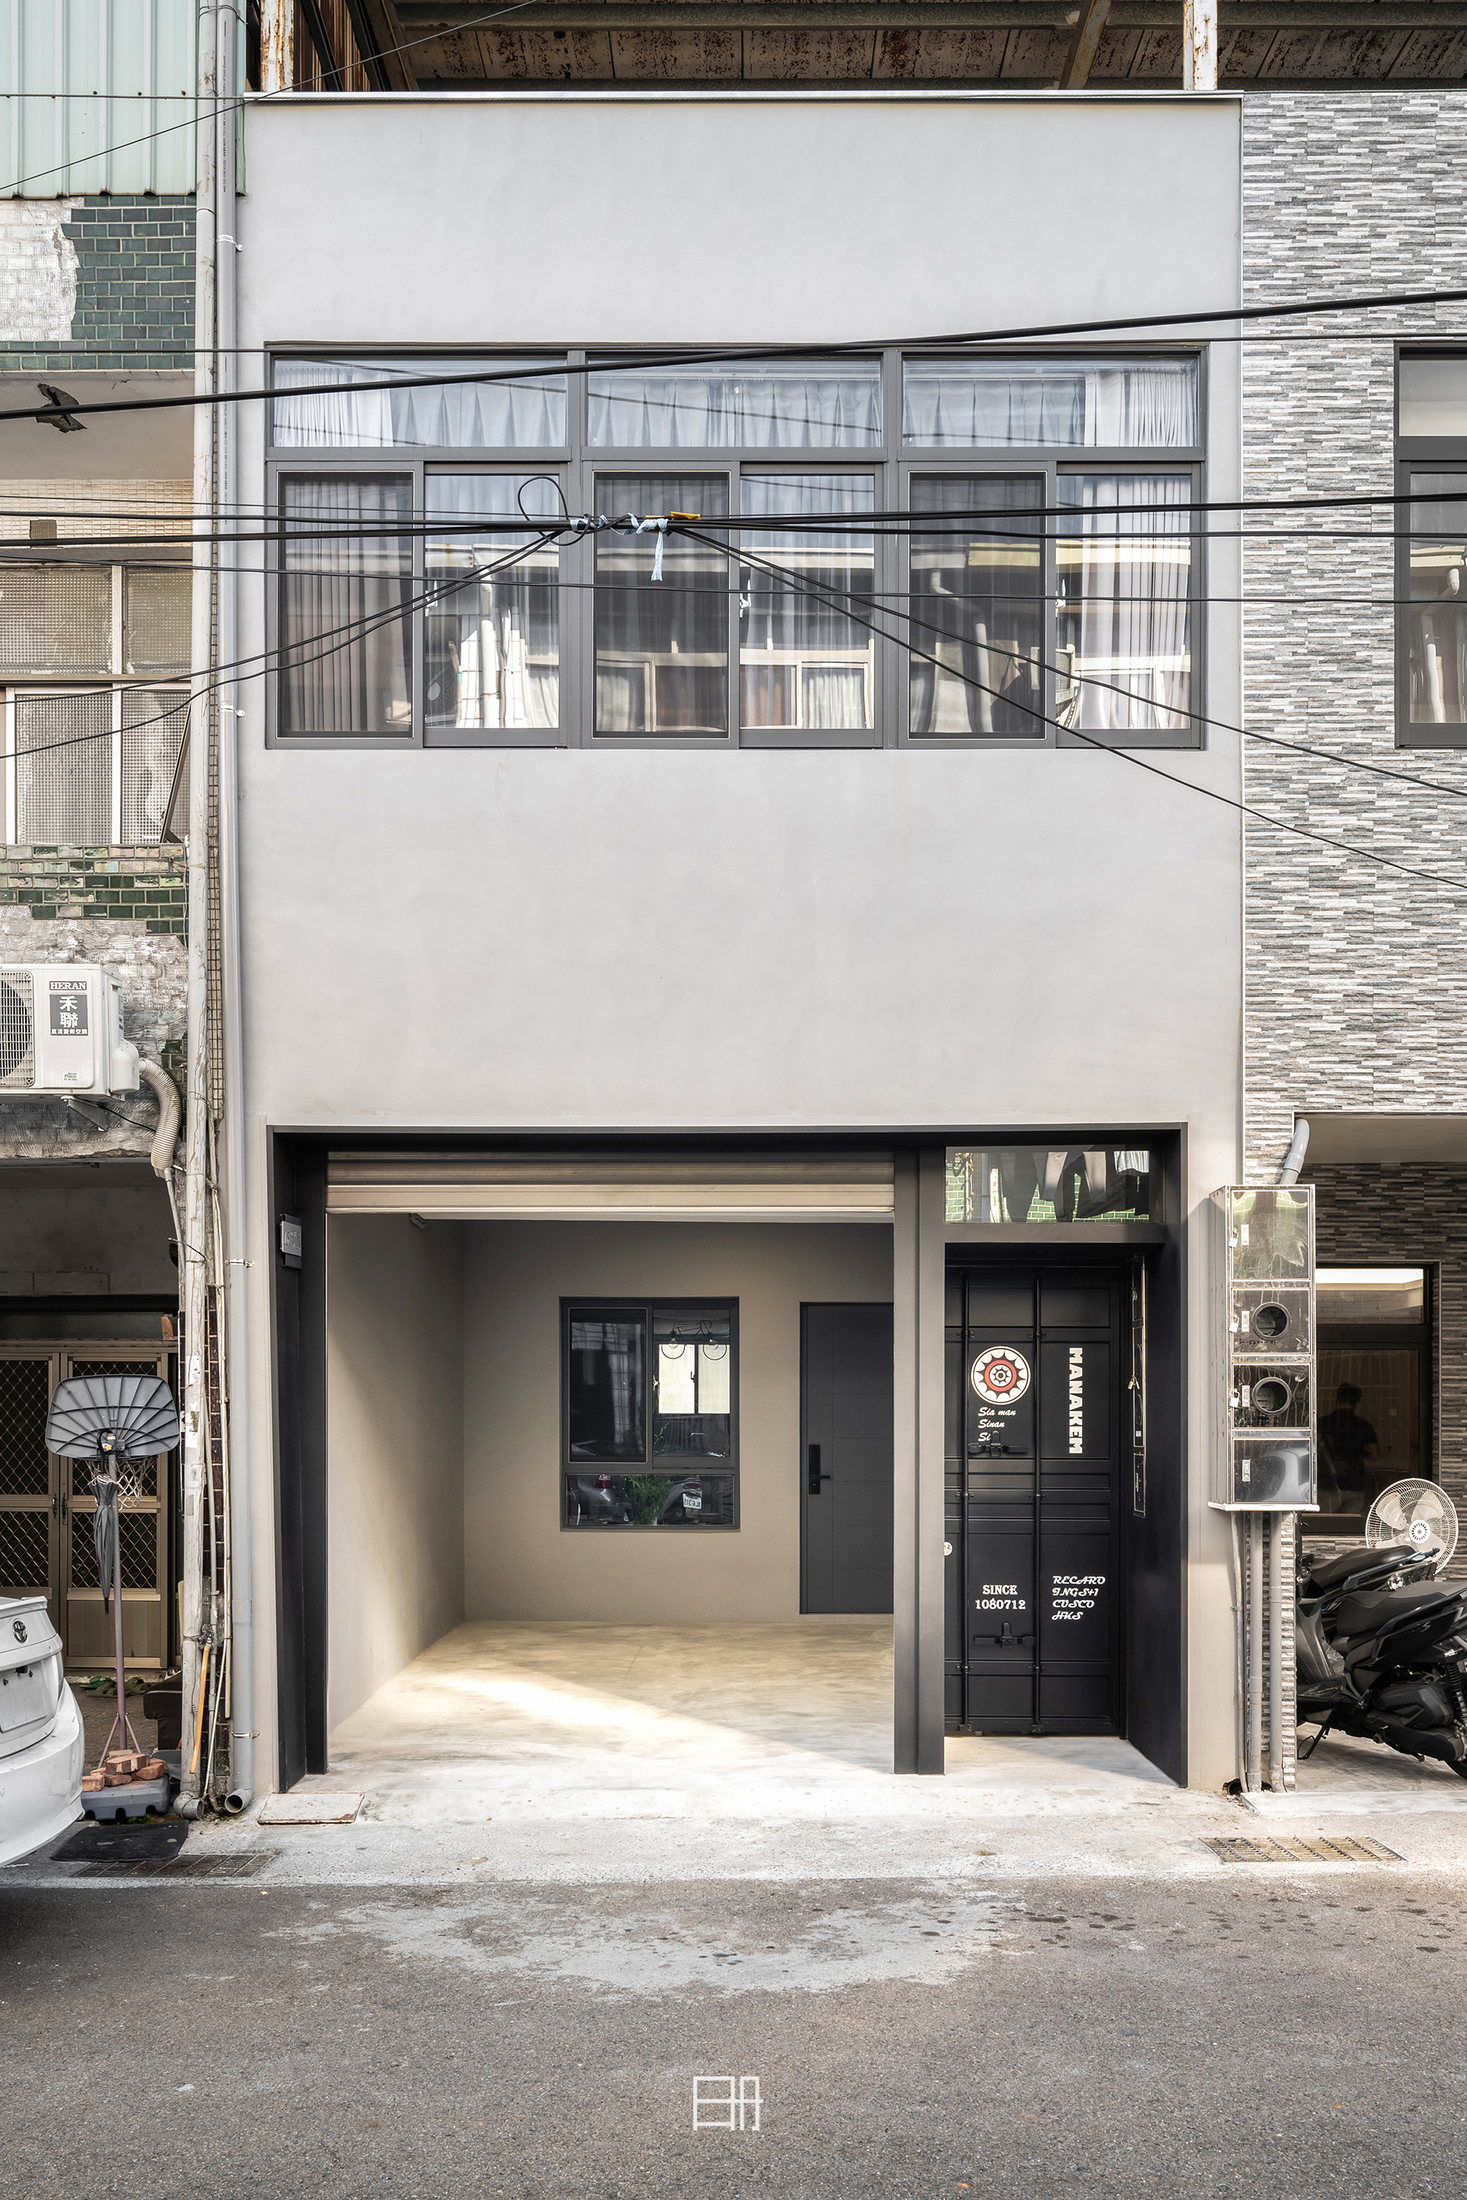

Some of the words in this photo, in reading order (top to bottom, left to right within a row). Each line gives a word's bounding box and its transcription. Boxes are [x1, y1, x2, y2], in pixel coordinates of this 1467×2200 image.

[50, 982, 86, 990] HERAN
[59, 995, 79, 1028] 禾聯
[1069, 1348, 1082, 1453] MANAKEM
[978, 1419, 1005, 1428] Sinan
[1053, 1576, 1105, 1584] RECARO
[983, 1585, 1018, 1595] SINCE
[975, 1599, 1026, 1610] 1080712
[1053, 1600, 1094, 1608] CUSCO
